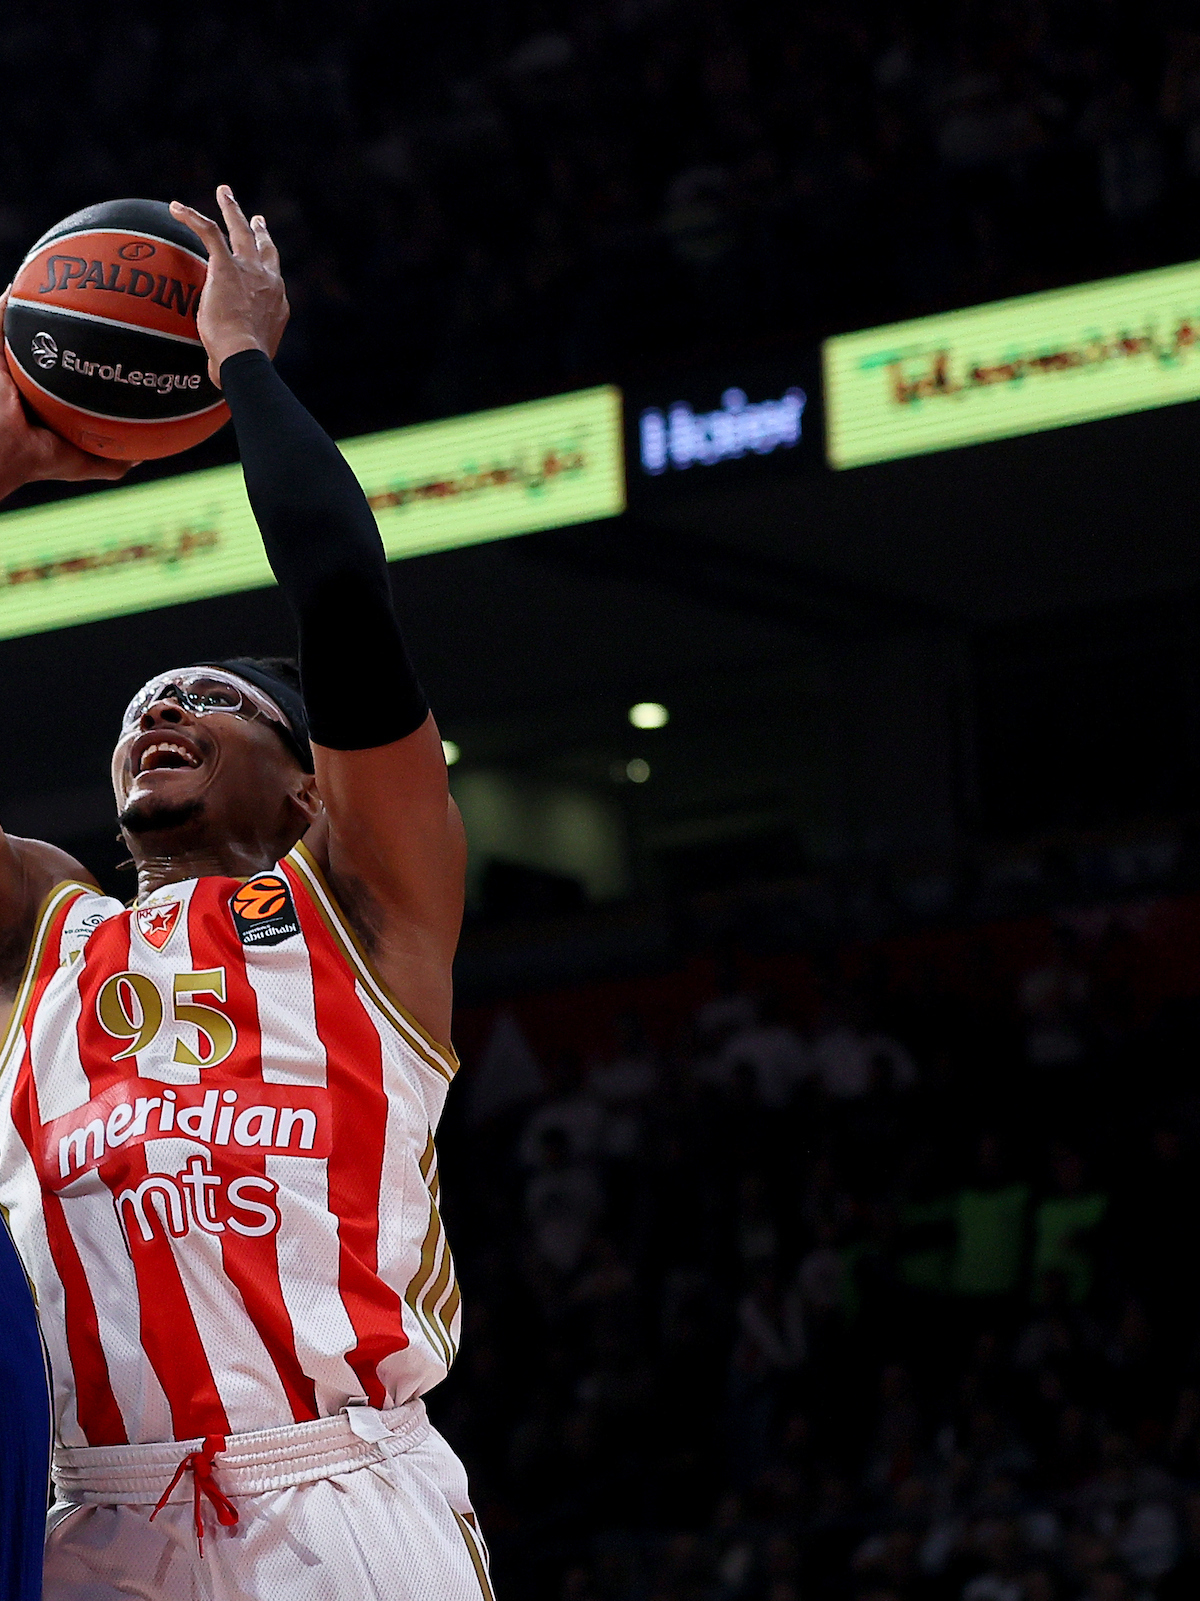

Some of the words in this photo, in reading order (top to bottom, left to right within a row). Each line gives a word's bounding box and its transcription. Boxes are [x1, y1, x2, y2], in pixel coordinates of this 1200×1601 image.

[38, 254, 202, 318] SPALDIN
[61, 350, 202, 394] EuroLeague
[243, 931, 265, 943] abu
[265, 922, 298, 937] dhabi
[96, 966, 238, 1069] 95
[58, 1088, 317, 1179] meridian
[117, 1158, 281, 1242] mts
